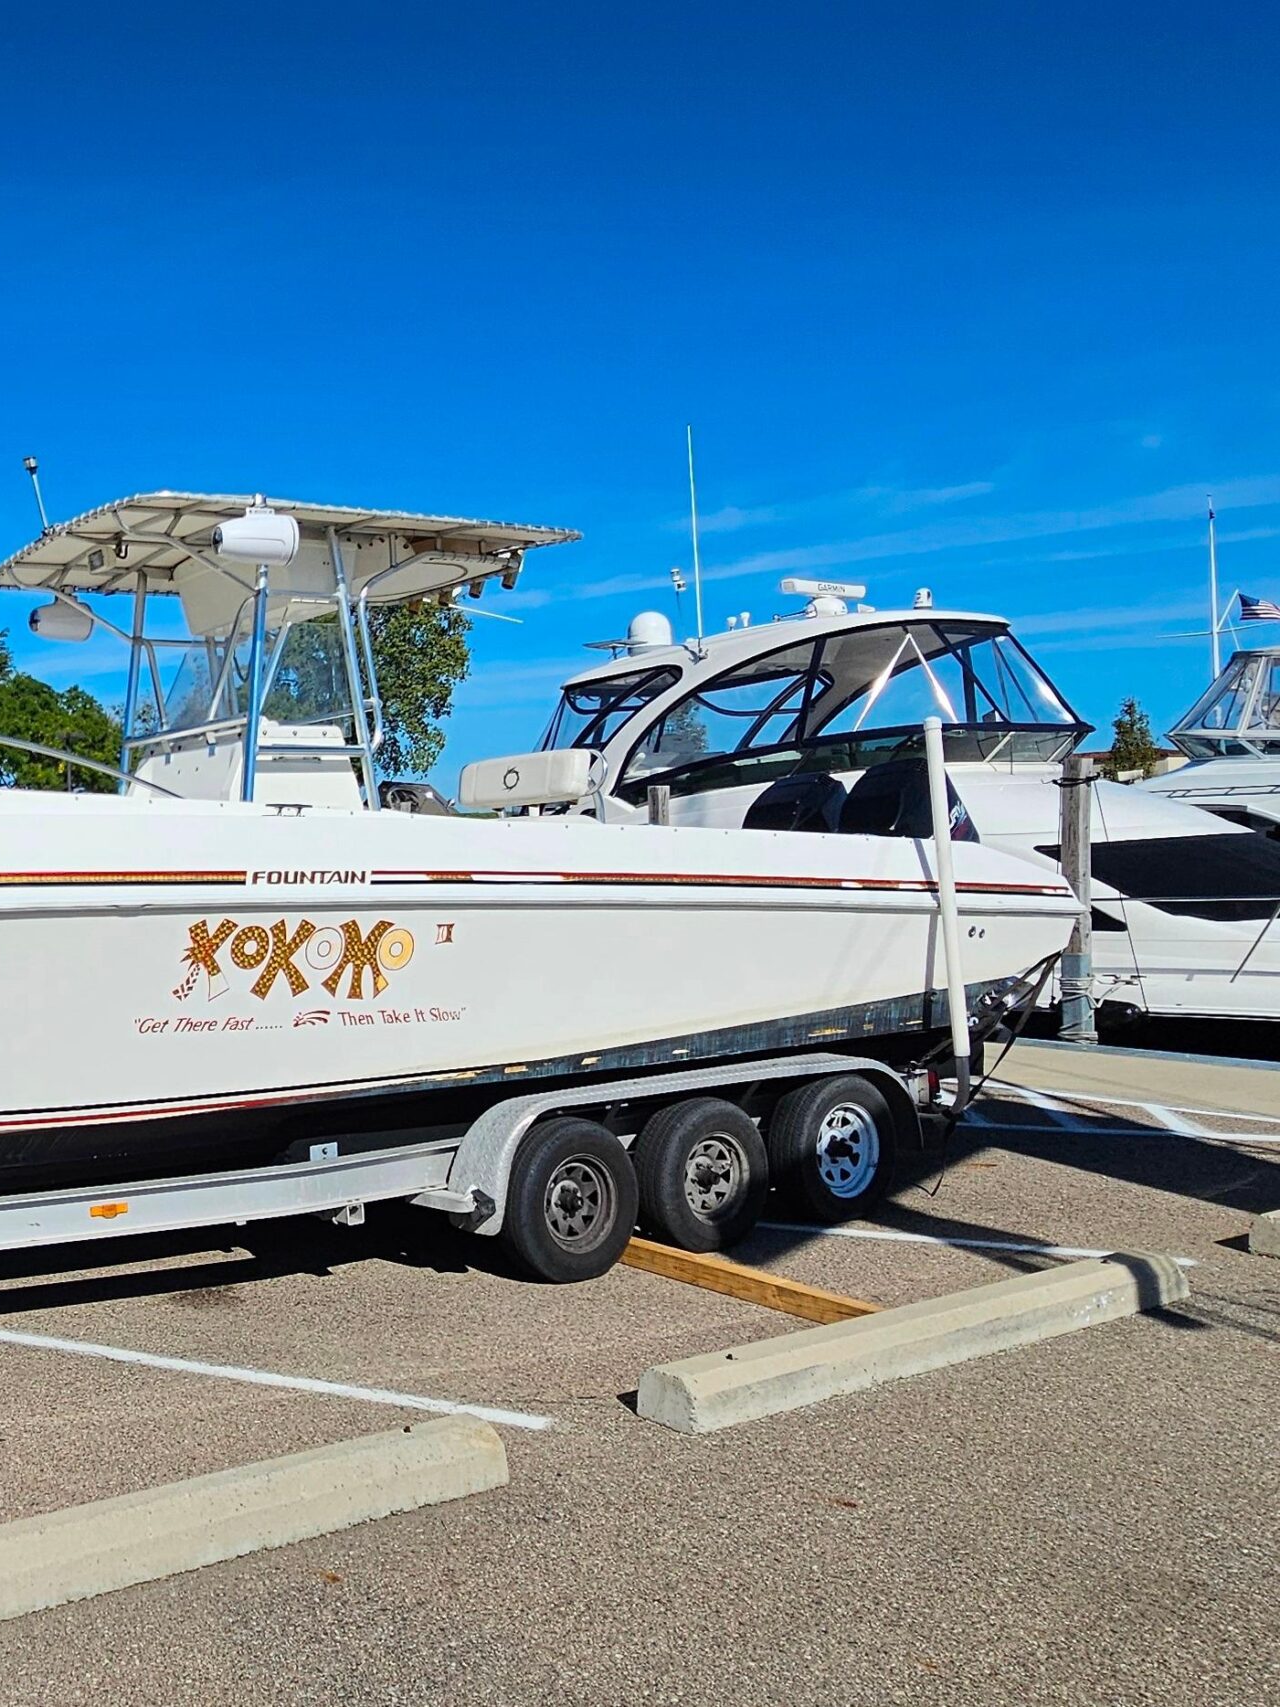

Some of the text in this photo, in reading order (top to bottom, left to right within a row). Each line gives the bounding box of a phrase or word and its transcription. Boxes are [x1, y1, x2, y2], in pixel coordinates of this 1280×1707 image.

[817, 583, 846, 593] GARMIN
[251, 870, 367, 885] FOUNTAIN
[171, 918, 415, 1001] KOKOMO
[173, 1017, 218, 1033] There
[337, 1011, 375, 1027] Then
[377, 1009, 411, 1025] Take
[414, 1008, 428, 1023] It
